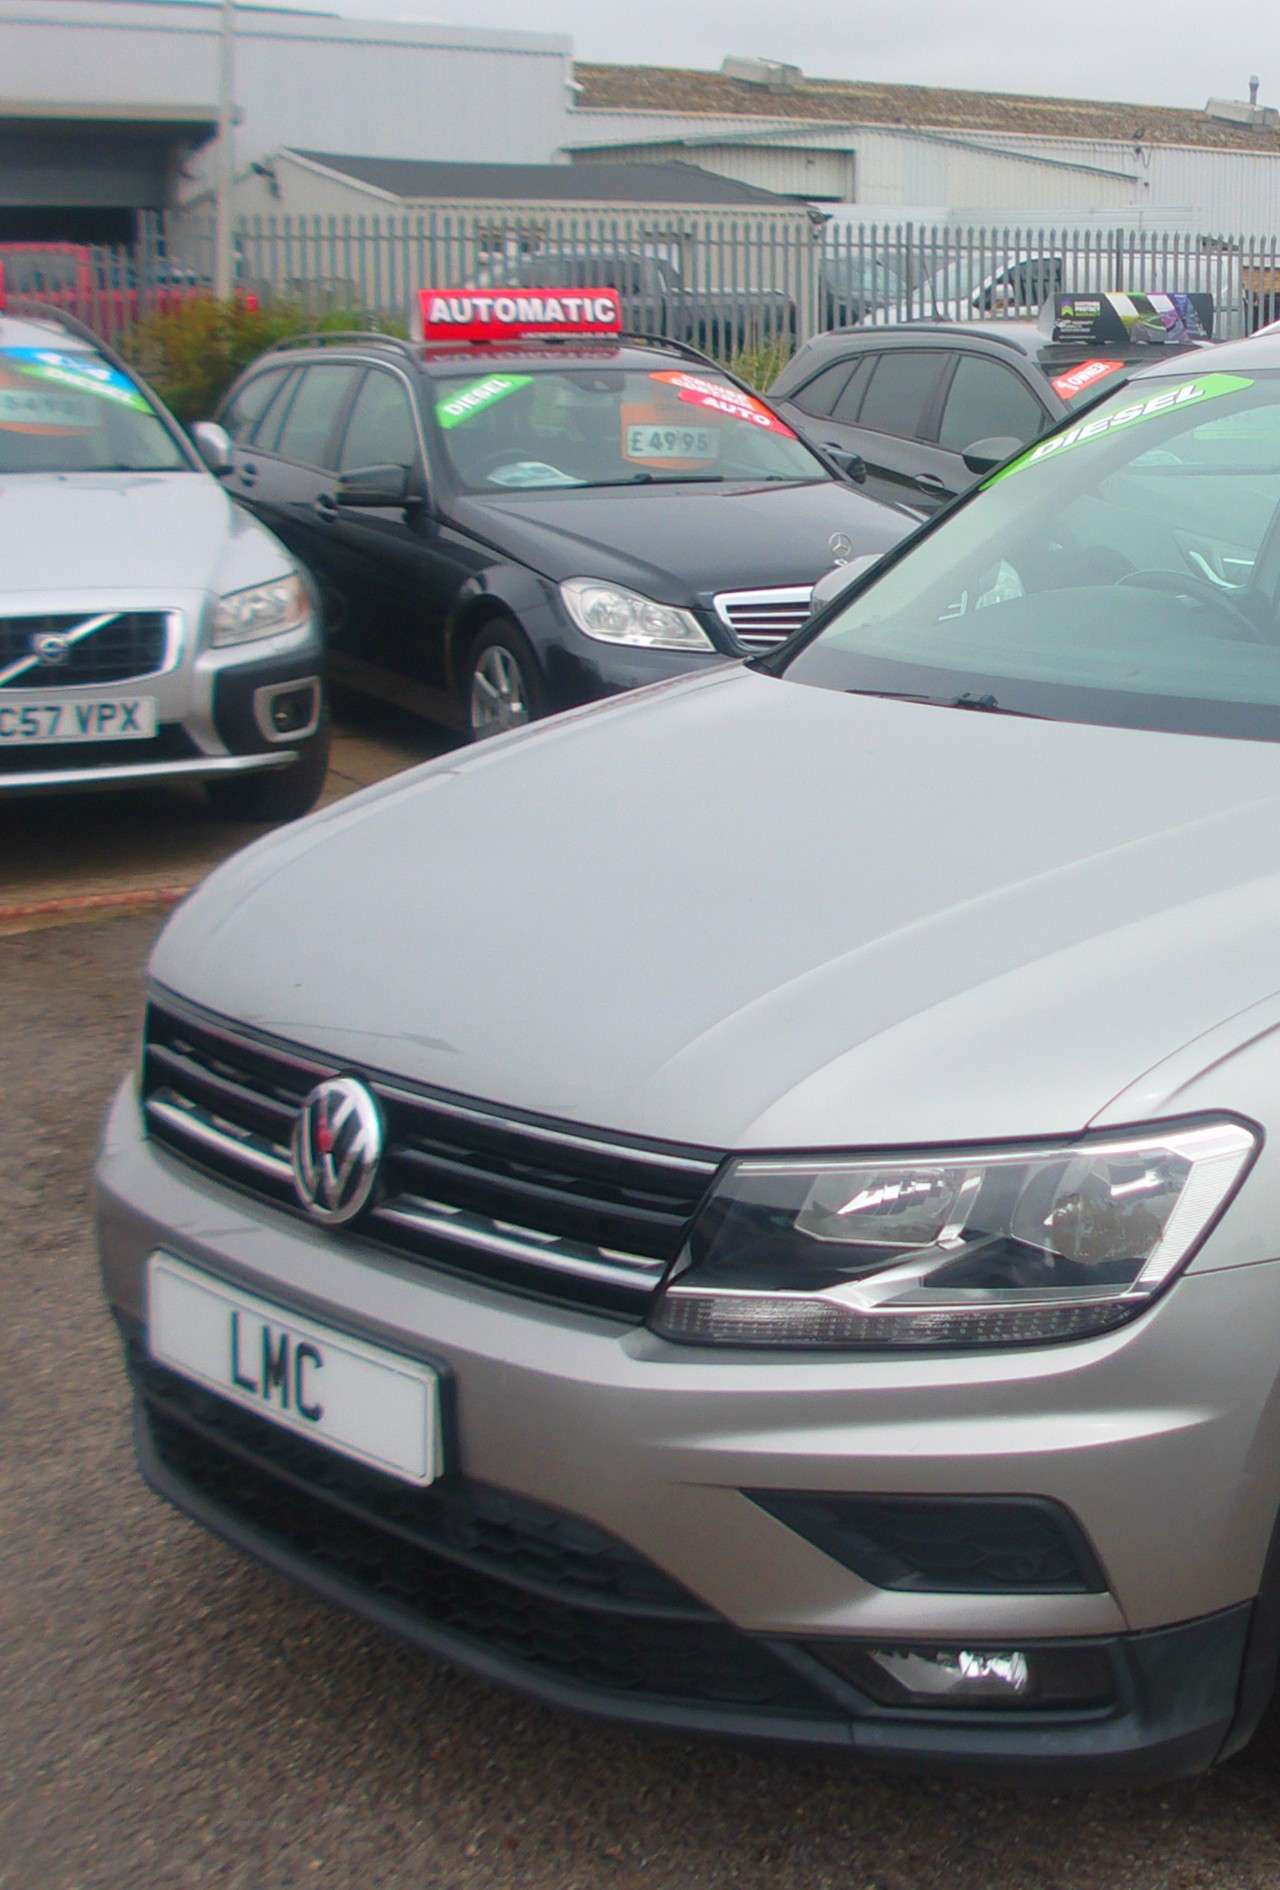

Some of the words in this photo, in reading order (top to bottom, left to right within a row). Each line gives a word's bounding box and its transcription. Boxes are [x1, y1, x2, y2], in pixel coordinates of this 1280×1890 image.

[429, 297, 616, 323] AUTOMATIC
[443, 378, 513, 416] DIESEL
[702, 396, 771, 427] AUTO
[1027, 384, 1206, 462] DIESEL
[74, 700, 141, 735] VPX
[230, 1310, 324, 1422] LMC
